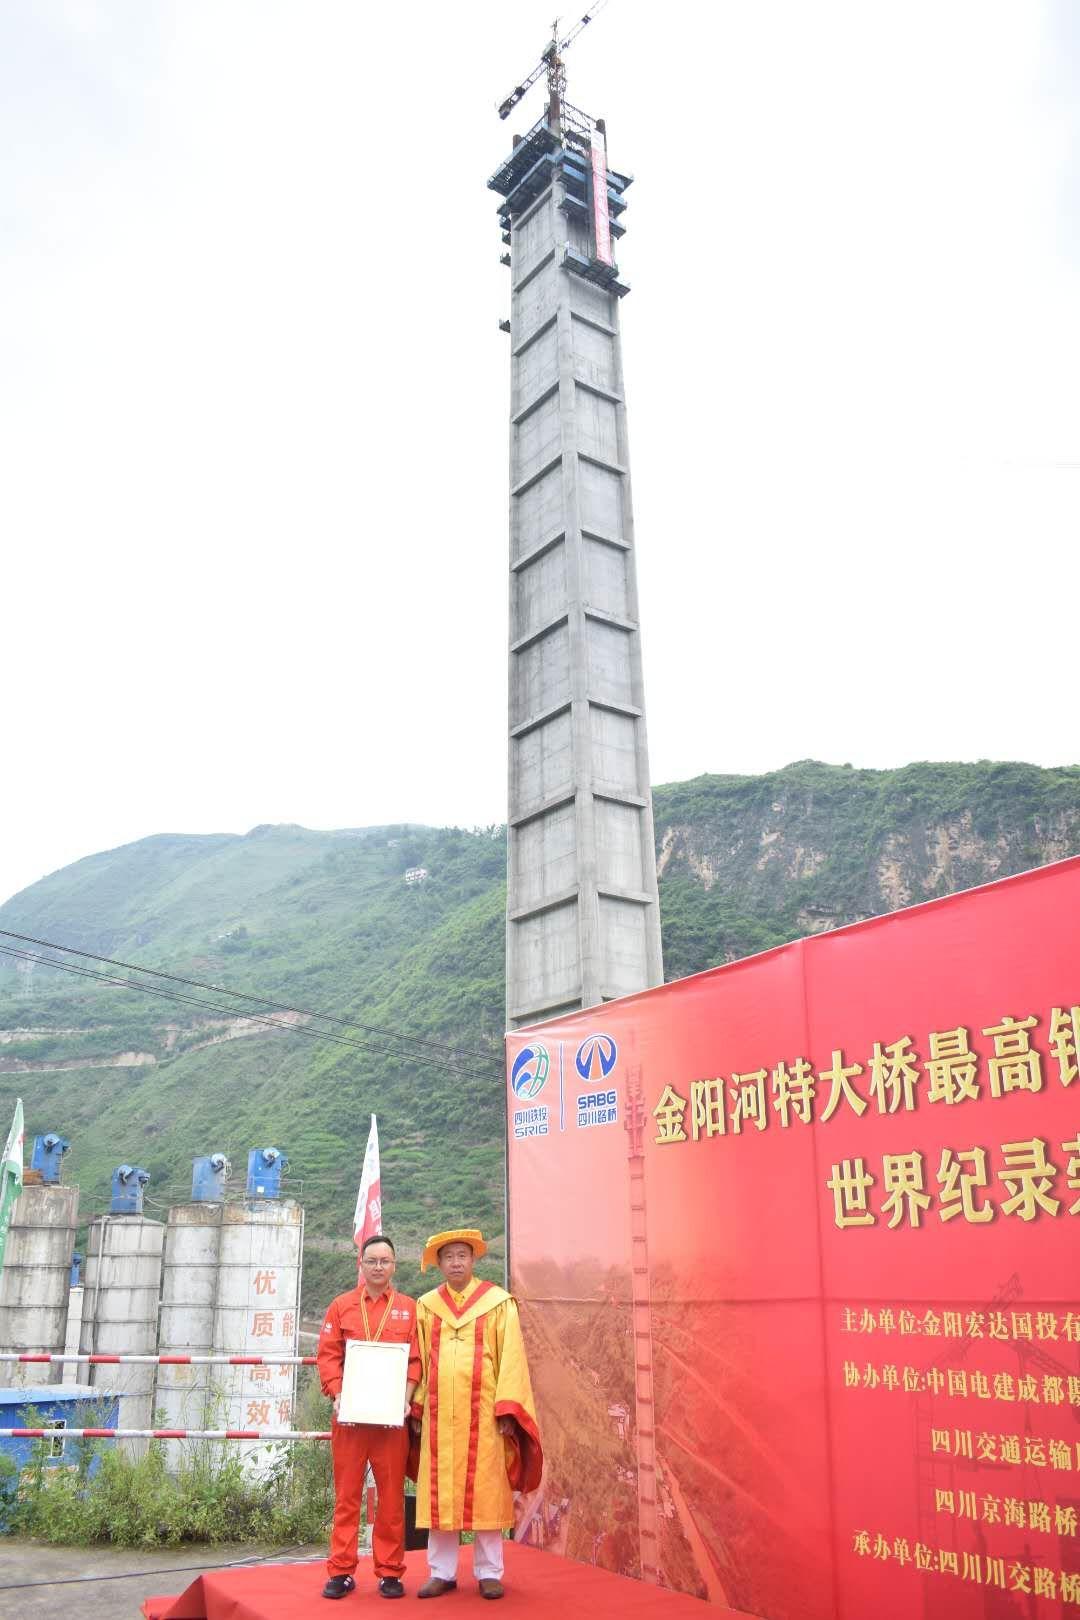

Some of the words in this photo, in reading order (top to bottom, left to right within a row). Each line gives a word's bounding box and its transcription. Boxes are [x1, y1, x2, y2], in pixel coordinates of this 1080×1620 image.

[577, 1090, 616, 1109] SRBG
[578, 1107, 617, 1126] 四川路桥
[514, 1123, 548, 1137] SRIG
[931, 1429, 1080, 1472] 四川交通运输
